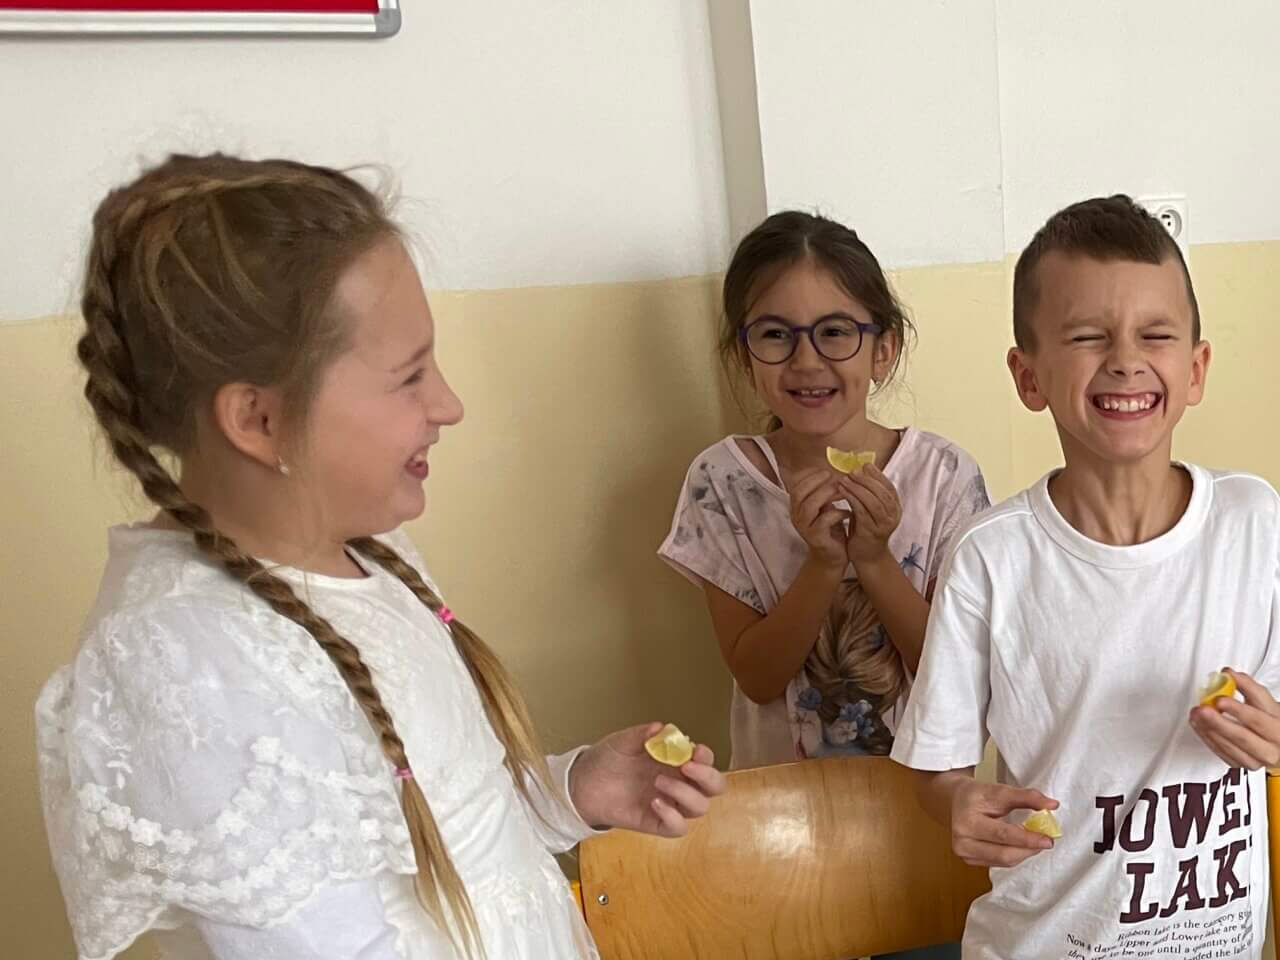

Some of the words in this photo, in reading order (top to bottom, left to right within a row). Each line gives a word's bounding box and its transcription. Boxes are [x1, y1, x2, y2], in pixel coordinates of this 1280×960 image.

[1119, 836, 1252, 923] LAK
[1184, 919, 1200, 929] the
[1171, 931, 1204, 941] Lower
[1157, 943, 1182, 954] until
[1216, 948, 1231, 958] the
